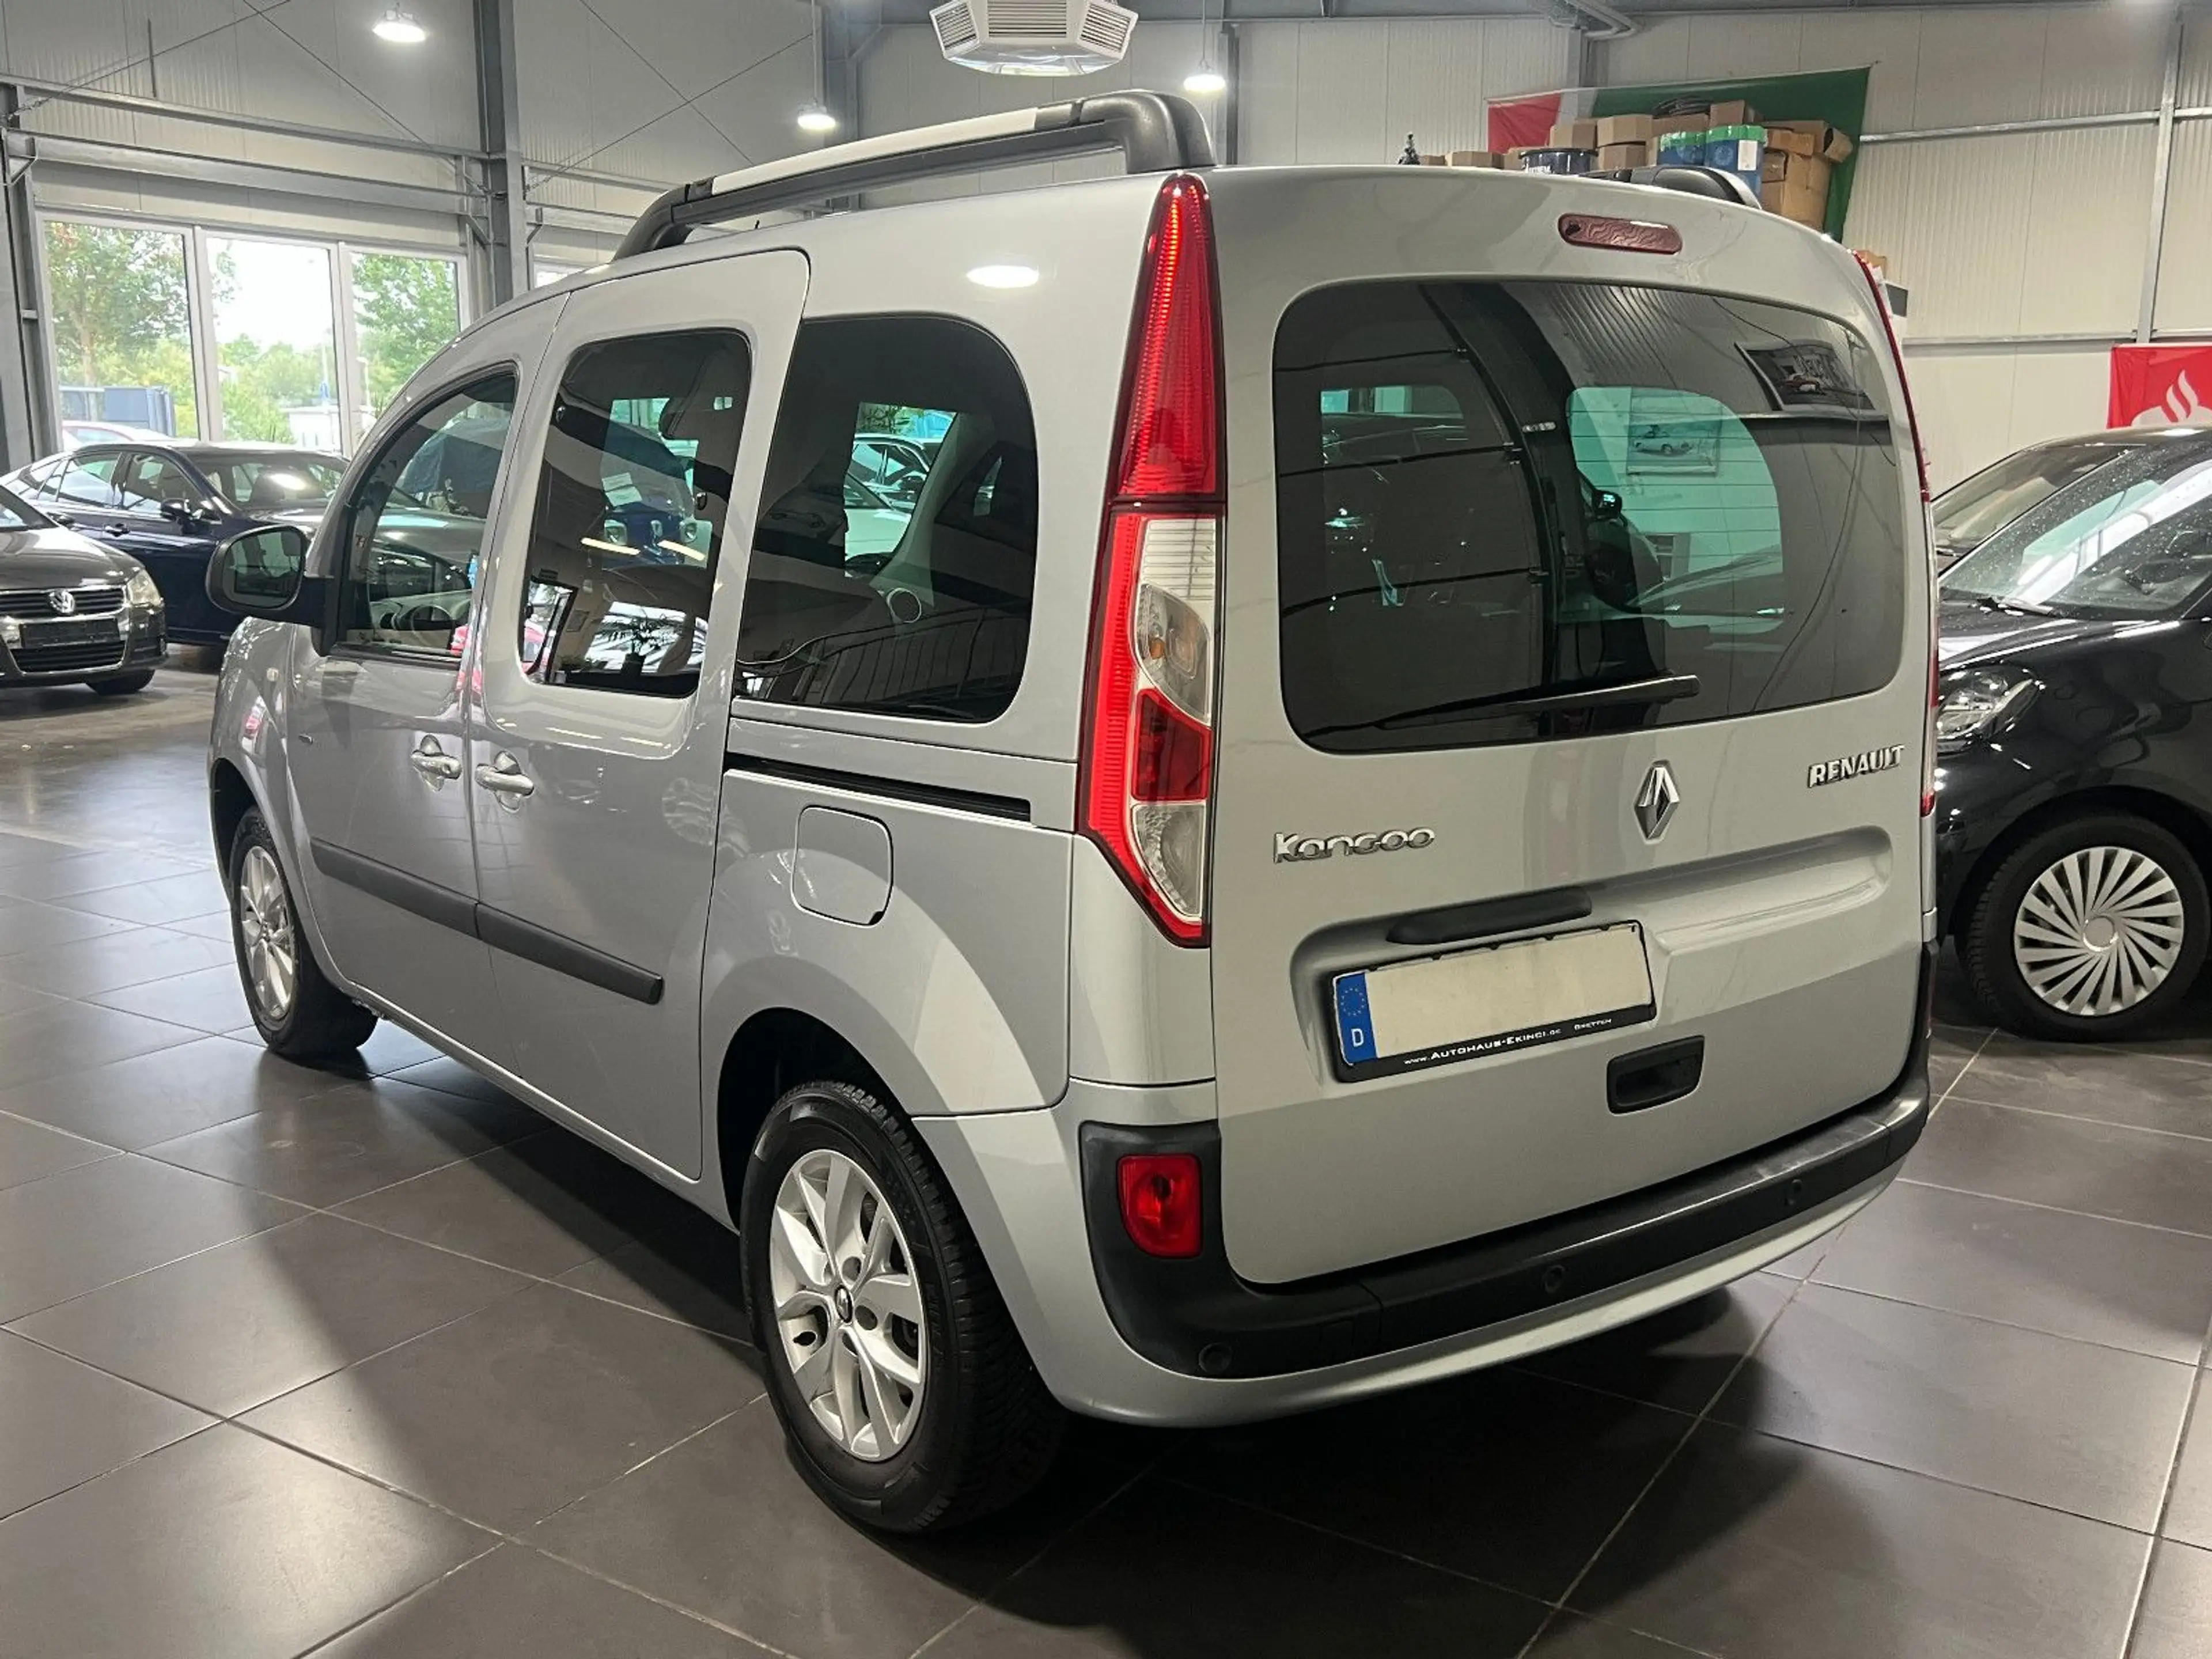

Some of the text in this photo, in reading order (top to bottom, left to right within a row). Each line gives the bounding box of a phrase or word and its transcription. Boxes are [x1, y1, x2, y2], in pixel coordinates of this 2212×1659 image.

[1808, 744, 1904, 788] RENAULT
[1274, 827, 1435, 864] Kangoo
[1351, 1028, 1364, 1047] D
